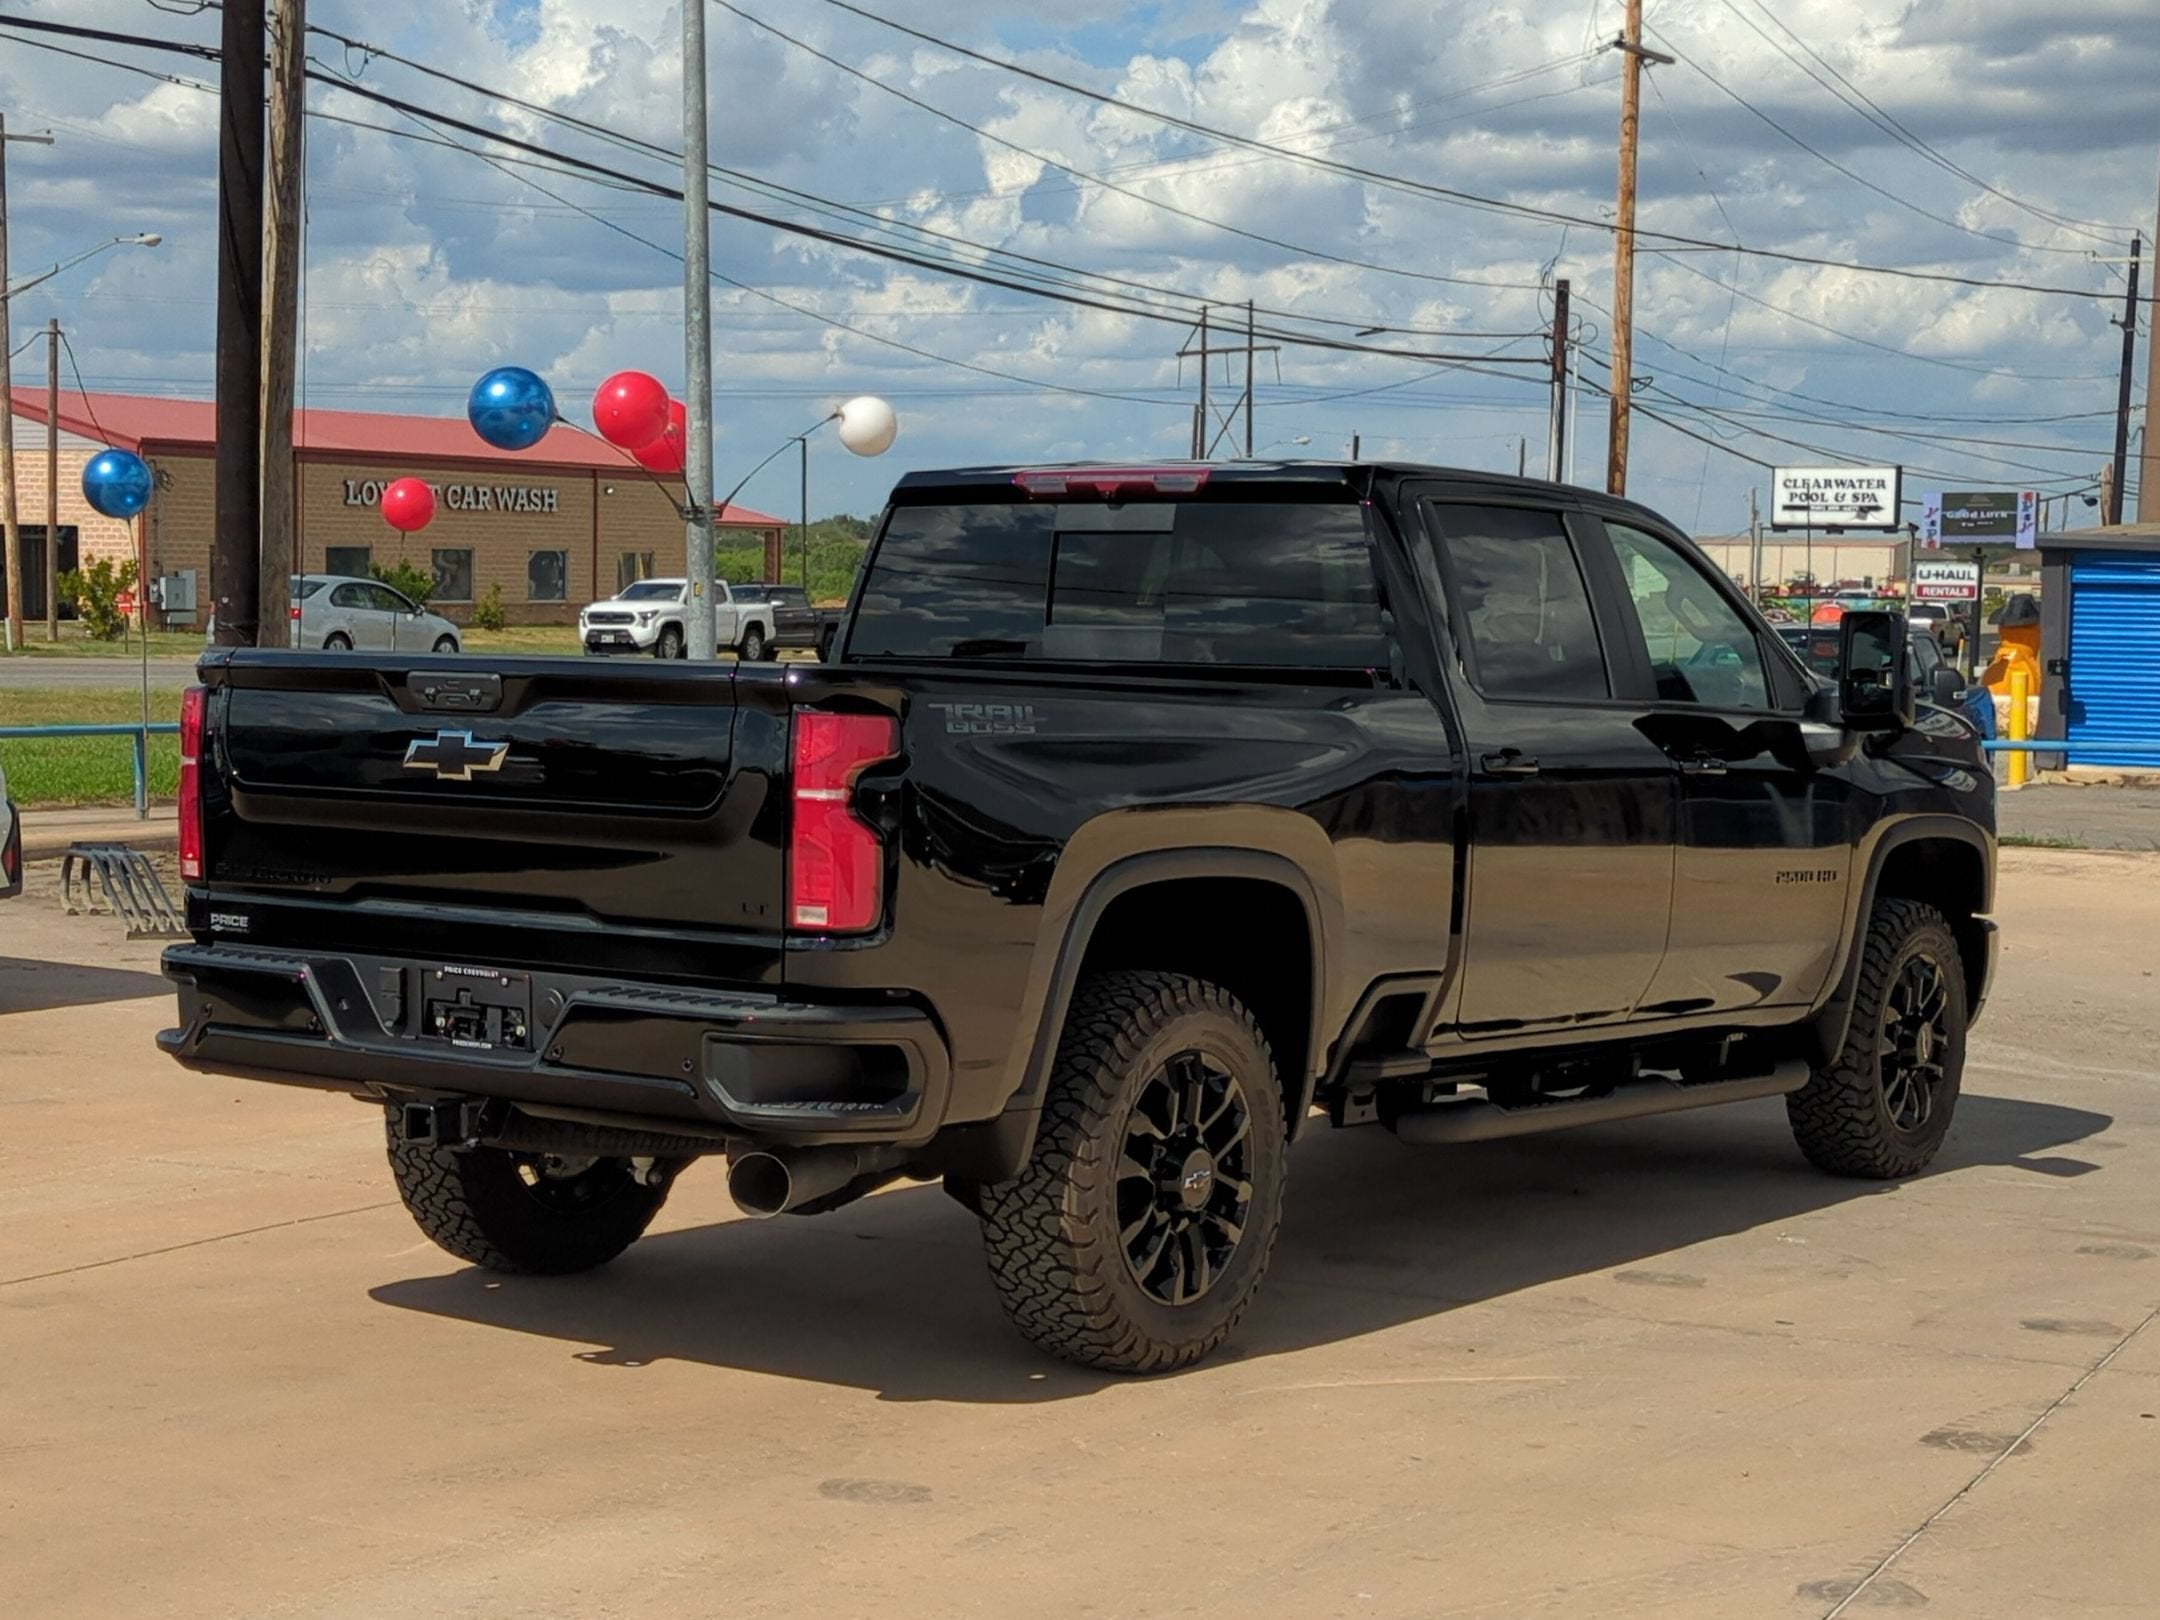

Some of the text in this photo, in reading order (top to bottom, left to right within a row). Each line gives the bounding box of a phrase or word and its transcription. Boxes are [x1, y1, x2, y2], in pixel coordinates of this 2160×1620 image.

[1783, 478, 1887, 490] CLEARWATER
[447, 484, 493, 511] CAR
[494, 486, 559, 513] WASH
[1789, 491, 1879, 504] POOL & SPA
[1918, 569, 1975, 580] U-HAUL
[1922, 586, 1969, 597] RENTALS
[928, 703, 1048, 722] TRAIL
[945, 721, 1036, 735] BOSS
[210, 912, 249, 928] PRICE
